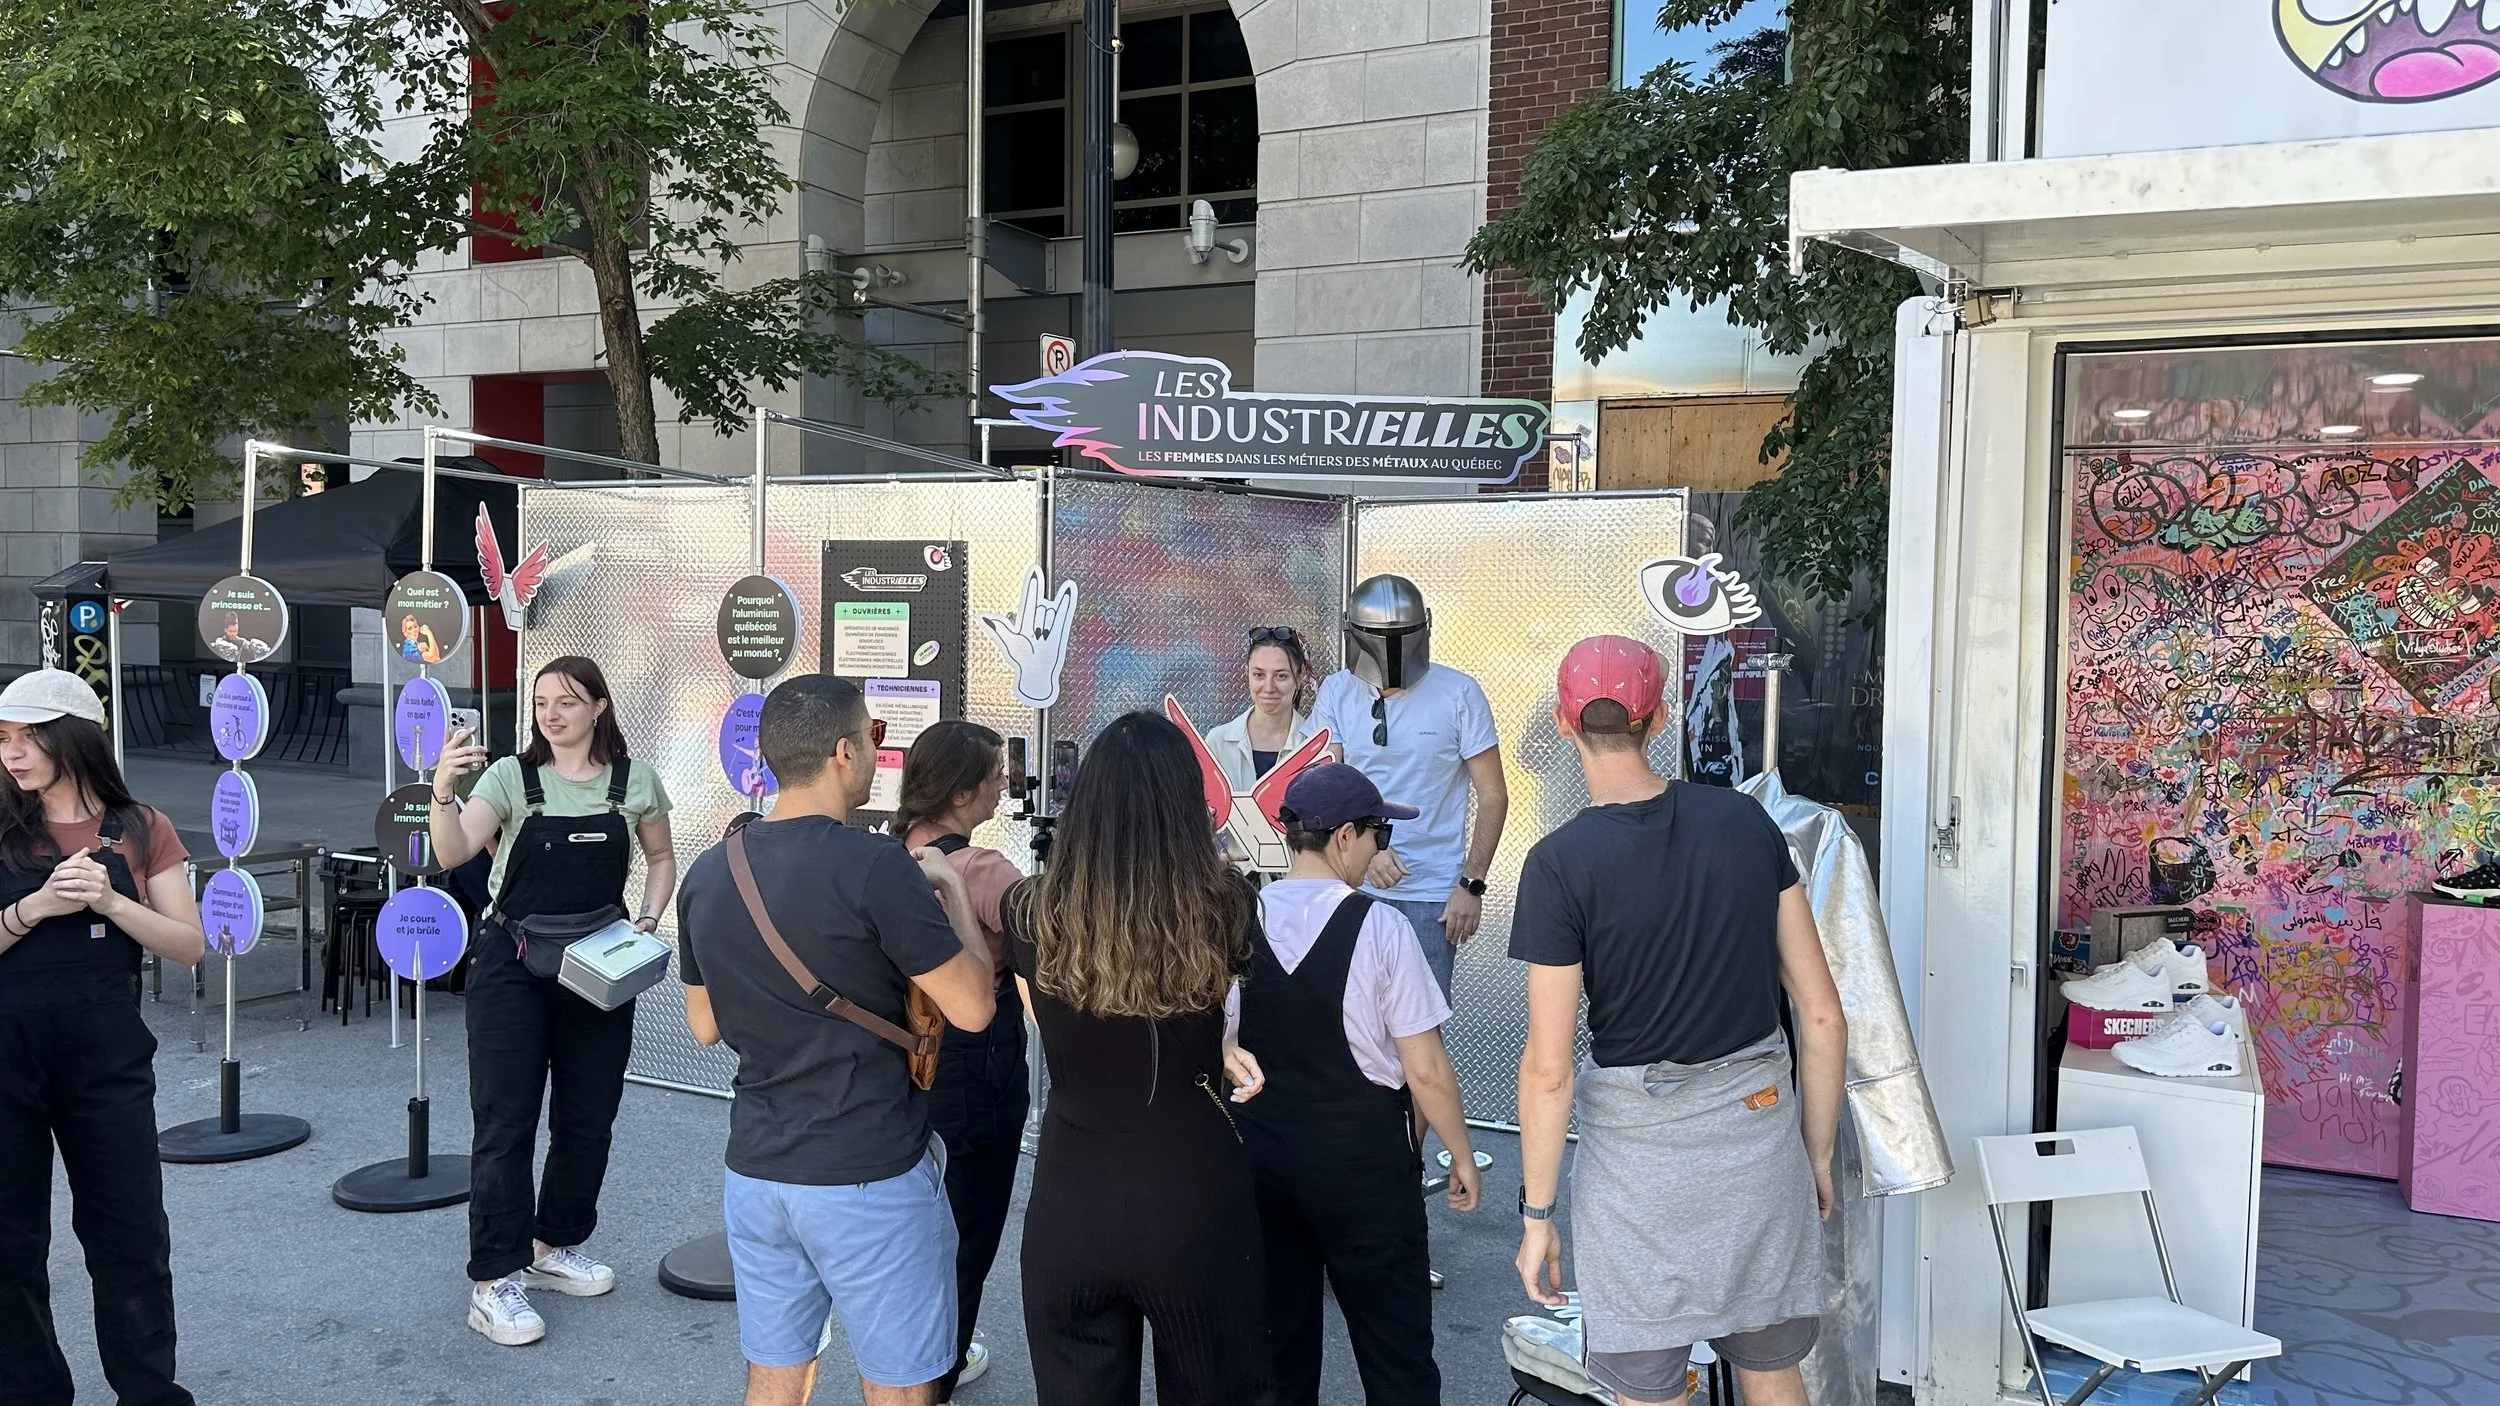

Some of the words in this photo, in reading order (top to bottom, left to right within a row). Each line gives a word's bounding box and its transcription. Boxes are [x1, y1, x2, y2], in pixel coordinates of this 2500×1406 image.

[1154, 371, 1218, 398] LES
[1138, 403, 1535, 449] INDUSTRIELLES
[1138, 451, 1161, 462] LES
[1164, 452, 1224, 463] FEMMES
[1226, 453, 1261, 464] DANS
[1263, 454, 1286, 465] LES
[1289, 452, 1342, 467] MÉTIERS
[1345, 456, 1370, 467] DES
[1372, 455, 1428, 468] MÉTAUX
[1431, 458, 1449, 469] AU
[1451, 457, 1502, 471] QUÉBEC
[862, 576, 925, 585] INDUSTRIELLES
[2312, 574, 2346, 593] Free
[227, 590, 236, 598] Je
[237, 591, 255, 599] suis
[407, 588, 424, 596] Quel
[211, 601, 252, 609] princesse
[398, 600, 414, 608] mon
[416, 599, 442, 608] métier
[737, 595, 774, 606] Pourquoi
[80, 606, 95, 628] P
[732, 609, 779, 618] l'aluminium
[734, 621, 777, 632] québécois
[727, 635, 740, 644] est
[742, 635, 749, 644] le
[750, 635, 784, 644] meilleur
[732, 649, 742, 657] au
[744, 648, 772, 657] monde
[774, 649, 779, 658] ?
[414, 712, 425, 720] quoi
[736, 709, 754, 718] C'est
[735, 725, 752, 733] pour
[404, 802, 414, 811] Je
[415, 802, 430, 811] sui
[393, 813, 430, 823] immort
[212, 887, 236, 897] Comment
[400, 914, 408, 922] Je
[410, 915, 436, 923] cours
[396, 926, 405, 934] et
[406, 926, 415, 935] je
[416, 926, 440, 935] brûle
[2104, 1018, 2165, 1035] SKECHERS
